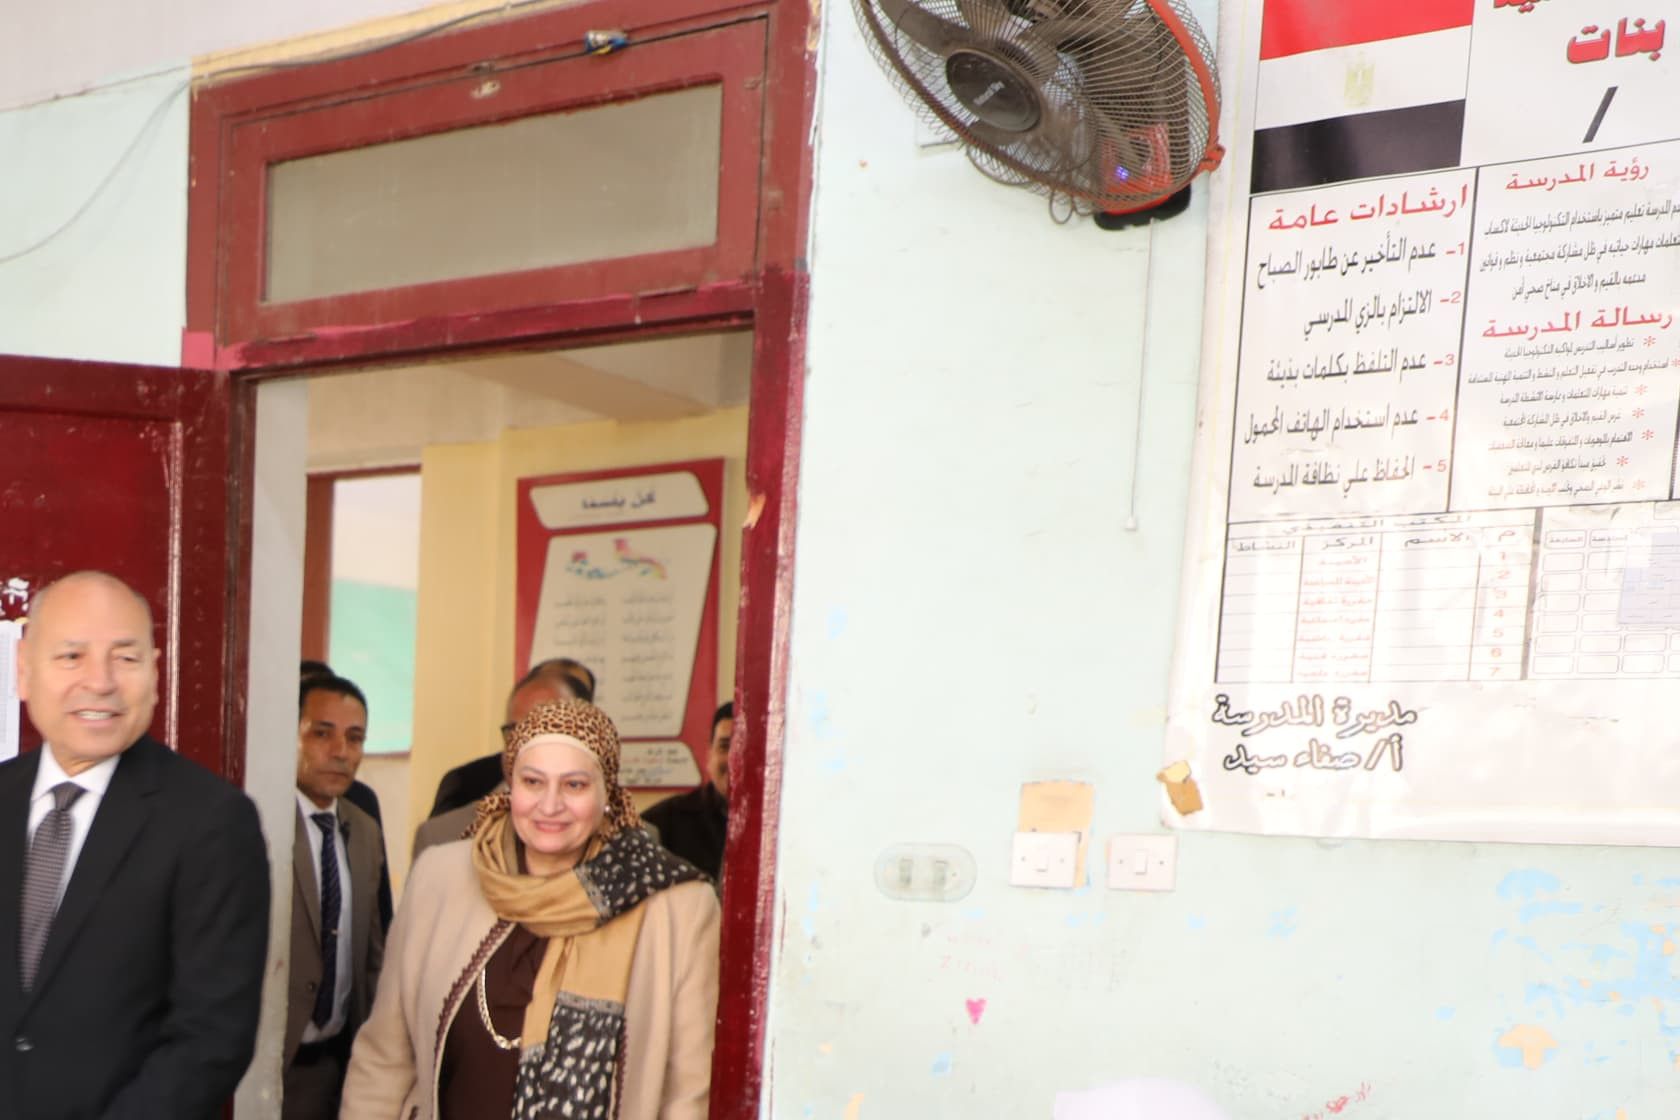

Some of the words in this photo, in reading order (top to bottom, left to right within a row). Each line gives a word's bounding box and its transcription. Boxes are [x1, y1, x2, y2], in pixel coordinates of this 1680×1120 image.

[1567, 17, 1665, 64] بنات
[1505, 163, 1595, 191] المدرسة
[1603, 157, 1650, 182] رؤية
[1268, 204, 1339, 231] عامة
[1350, 184, 1468, 220] ارشادات
[1623, 202, 1645, 224] تعليم
[1304, 246, 1338, 280] طابور
[1341, 254, 1358, 276] عن
[1361, 230, 1407, 274] التأخير
[1408, 242, 1436, 272] عدم
[1257, 250, 1303, 290] الصباح
[1304, 297, 1353, 342] المدرسي
[1355, 294, 1386, 335] بالزي
[1389, 289, 1433, 331] الالتزام
[1482, 310, 1581, 341] المدرسة
[1591, 305, 1674, 329] رسالة
[1267, 357, 1299, 389] بذيئة
[1302, 352, 1349, 384] بكلمات
[1353, 347, 1398, 376] التلفظ
[1399, 353, 1426, 384] عدم
[1244, 404, 1283, 445] المحمول
[1287, 408, 1330, 442] الهاتف
[1332, 402, 1391, 443] استخدام
[1392, 408, 1418, 441] عدم
[1253, 463, 1299, 495] المدرسة
[1302, 461, 1340, 486] نظافة
[1372, 455, 1416, 482] الحفاظ
[1211, 693, 1324, 738] المدرسة
[1333, 696, 1418, 739] مديرة
[1222, 743, 1288, 776] سيد
